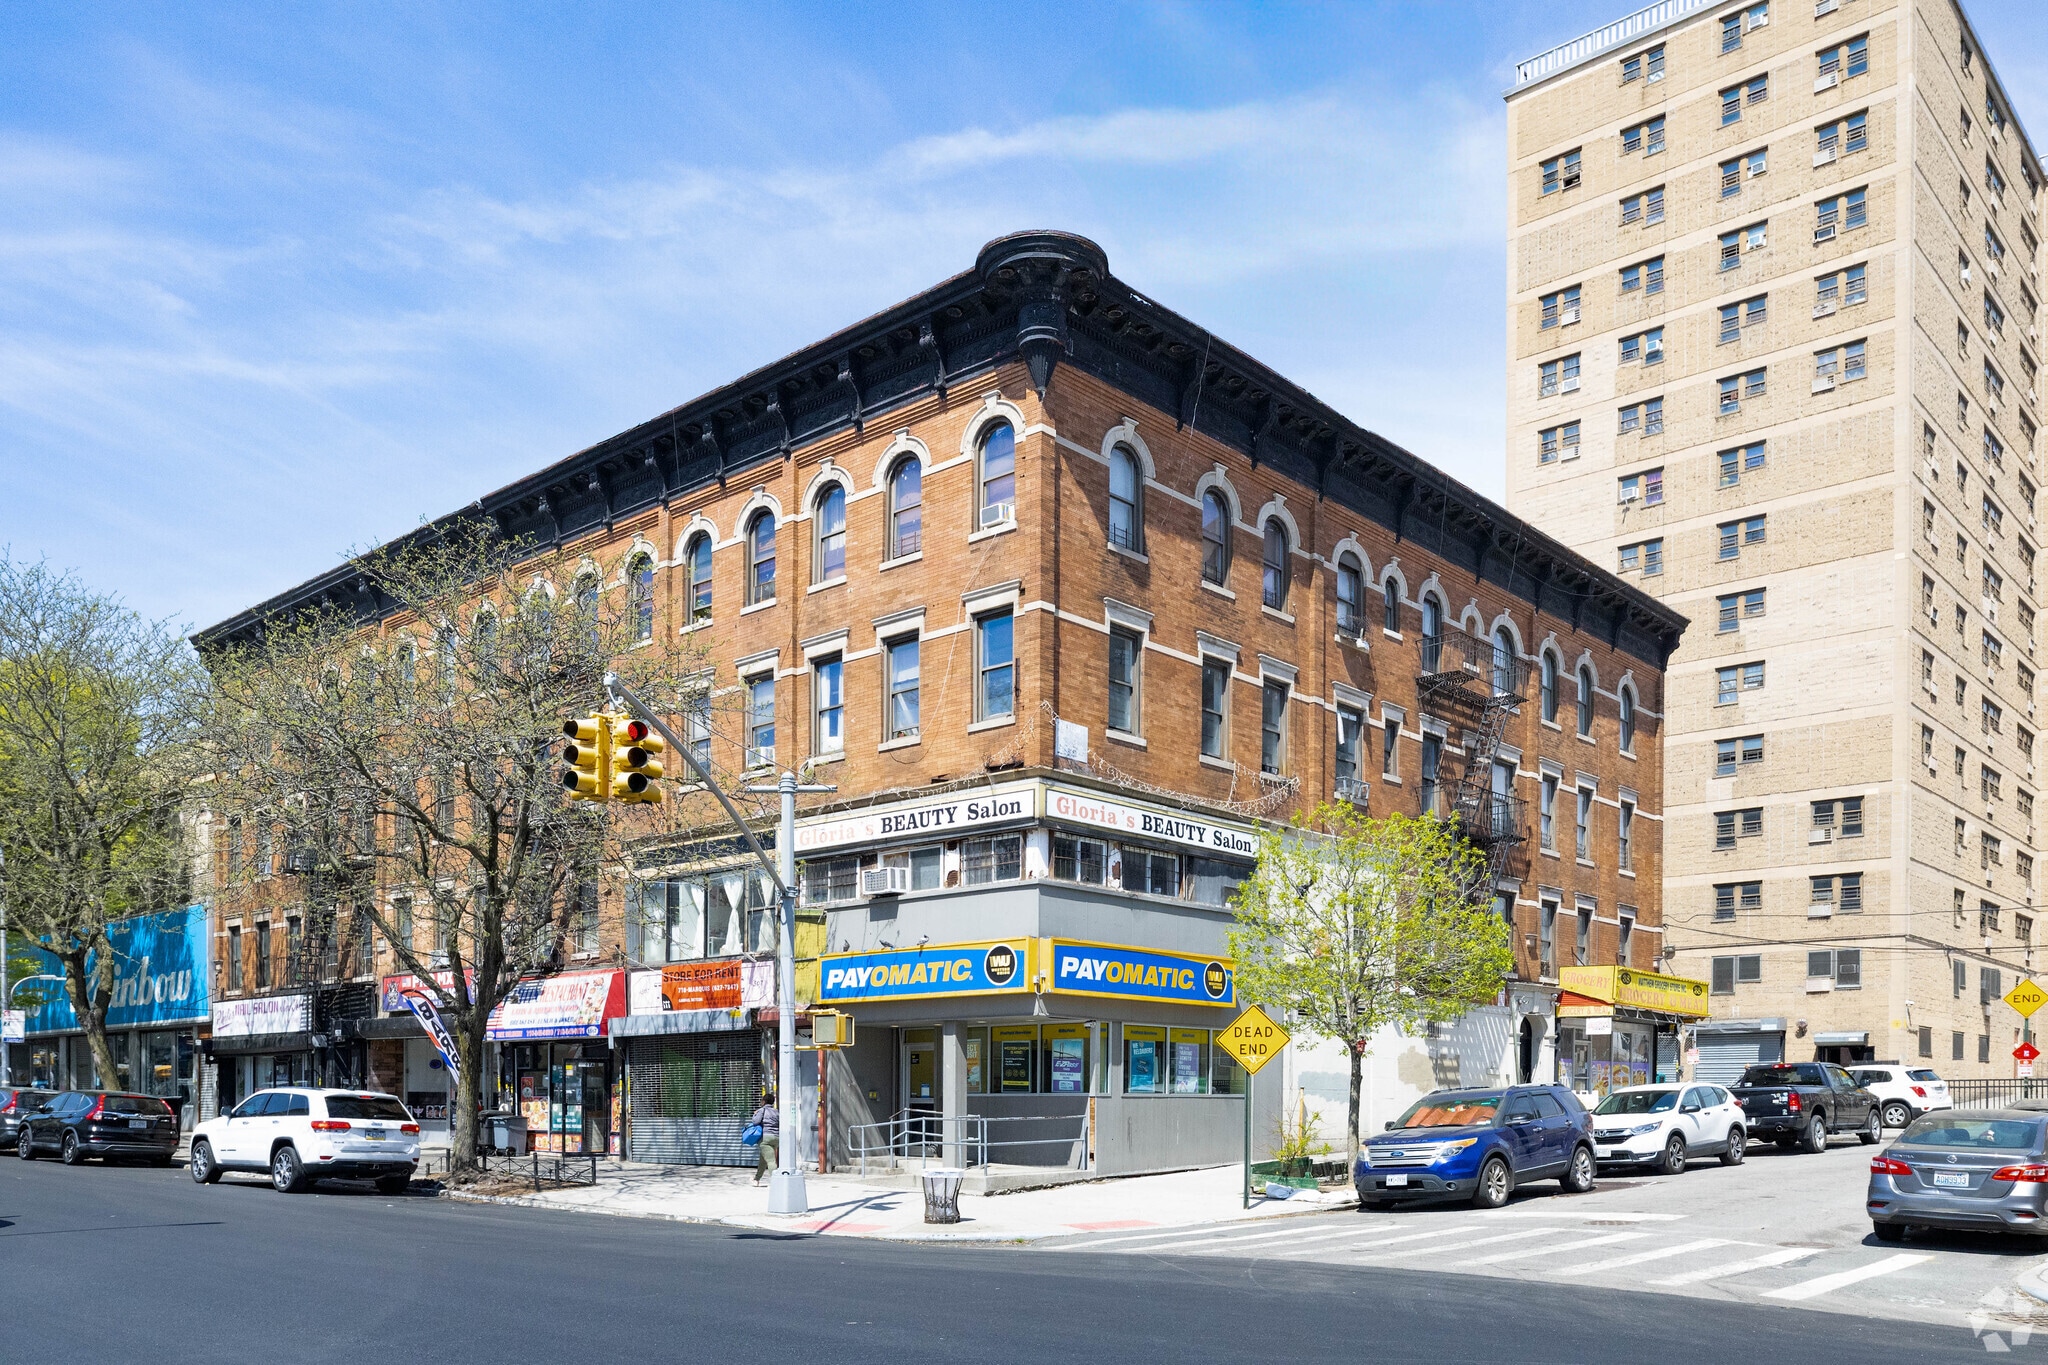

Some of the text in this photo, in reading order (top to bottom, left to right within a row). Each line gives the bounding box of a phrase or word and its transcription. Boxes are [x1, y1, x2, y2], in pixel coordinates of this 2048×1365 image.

[799, 800, 1022, 846] Gloria's BEAUTY Salon
[1056, 796, 1252, 853] Gloria's BEAUTY Salon
[437, 971, 454, 986] MX
[663, 967, 740, 983] STORE FOR RENT
[826, 959, 973, 989] PAYOMATIC
[1061, 956, 1195, 990] PAYOMATIC
[1563, 971, 1612, 990] GROCERY
[539, 982, 590, 1002] RESTAURANT
[1619, 988, 1666, 1006] GROCERY
[1680, 997, 1705, 1011] MEAT
[2013, 994, 2041, 1003] END
[235, 1003, 251, 1015] NAIL
[253, 1001, 279, 1014] SALON
[1234, 1026, 1273, 1038] DEAD
[1239, 1044, 1268, 1055] END
